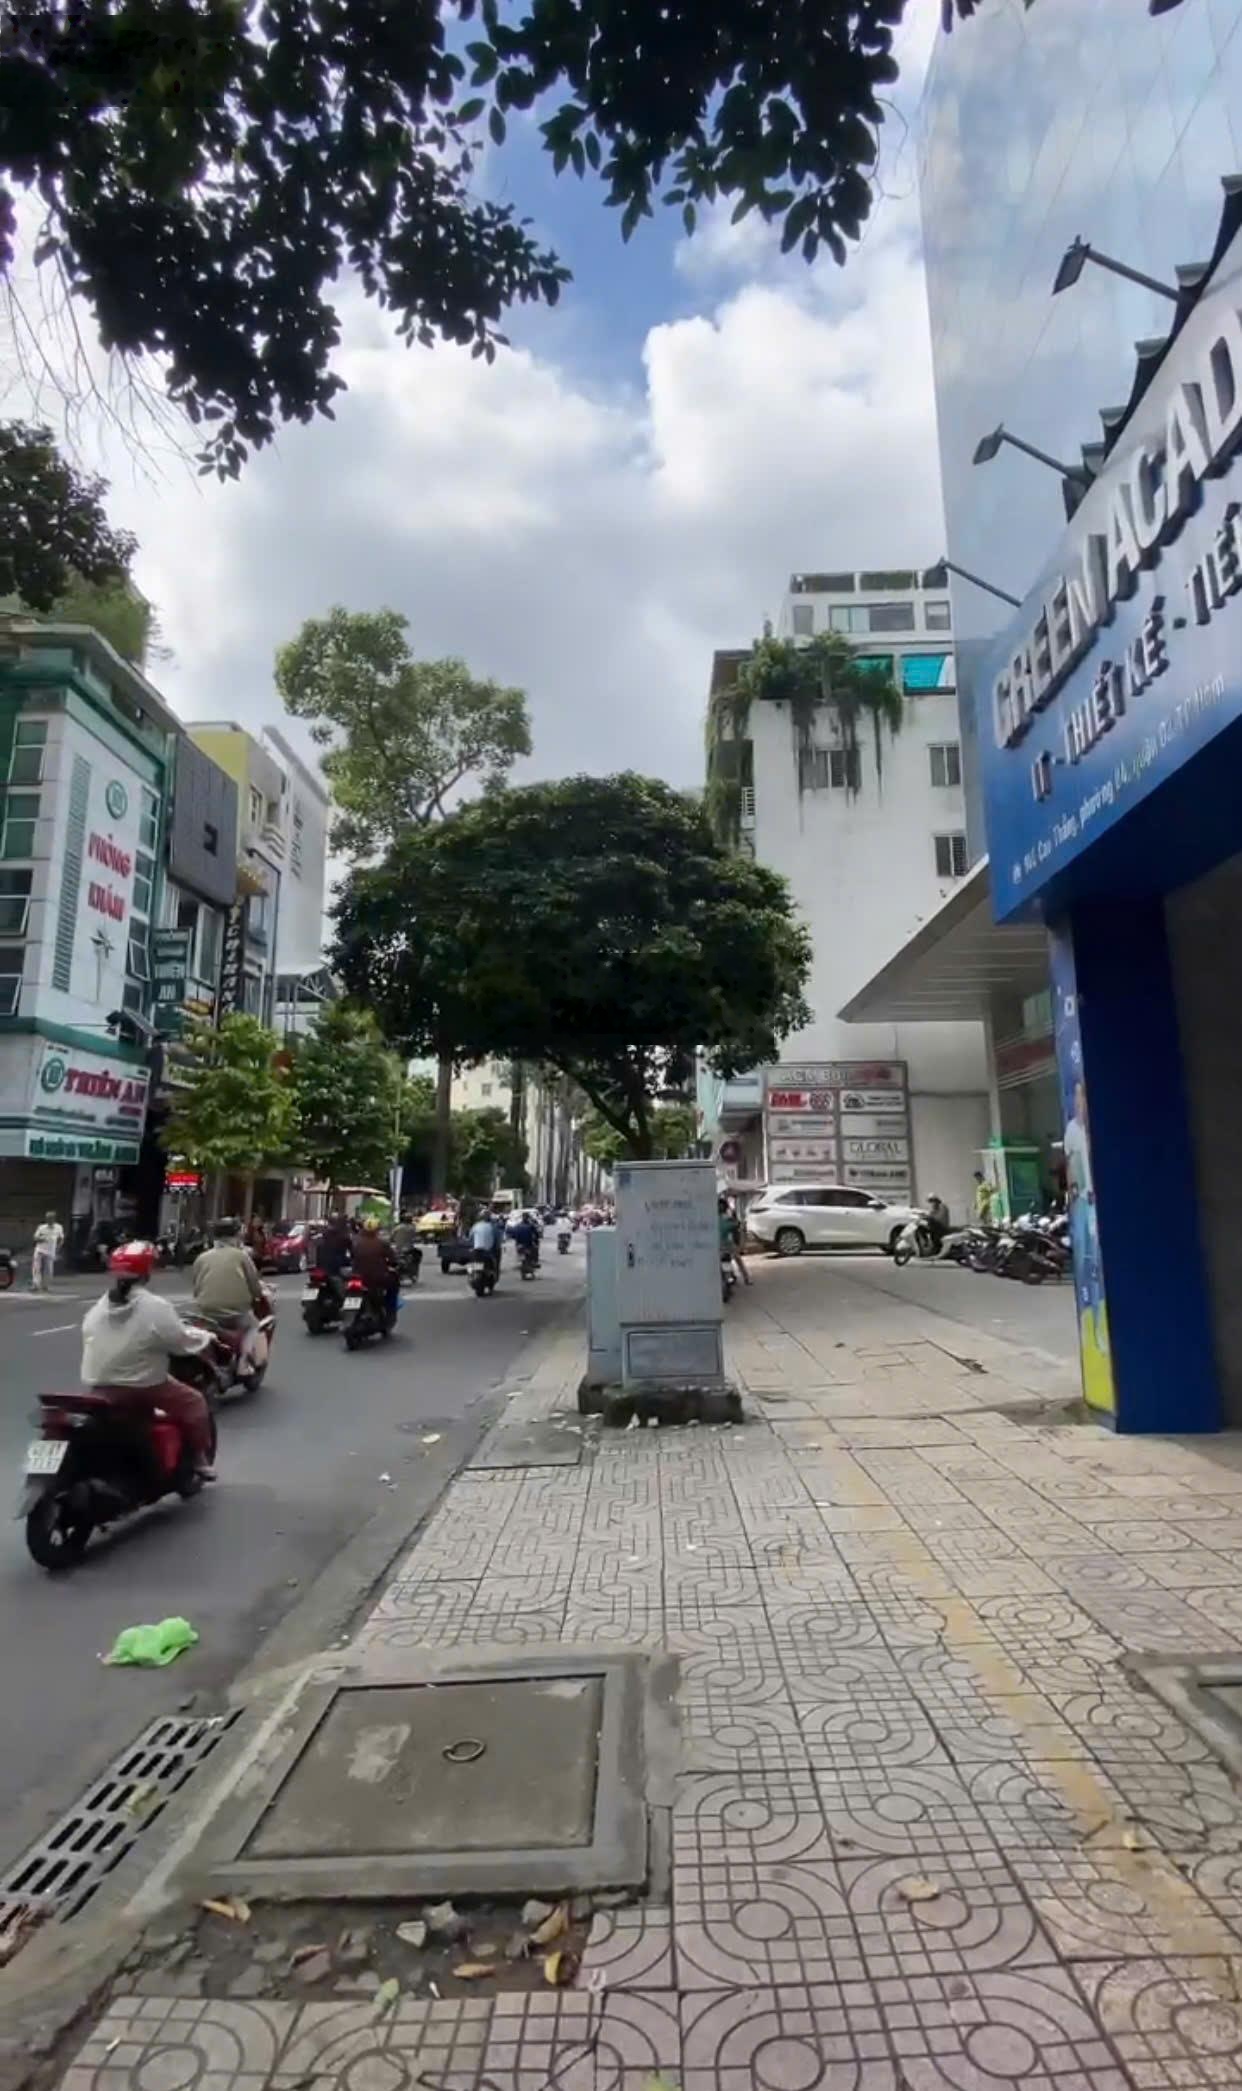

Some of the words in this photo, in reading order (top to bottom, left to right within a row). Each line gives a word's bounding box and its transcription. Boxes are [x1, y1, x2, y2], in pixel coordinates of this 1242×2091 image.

[993, 535, 1107, 749] GREEN
[88, 832, 131, 878] PHÒNG
[88, 881, 125, 922] KHÁM
